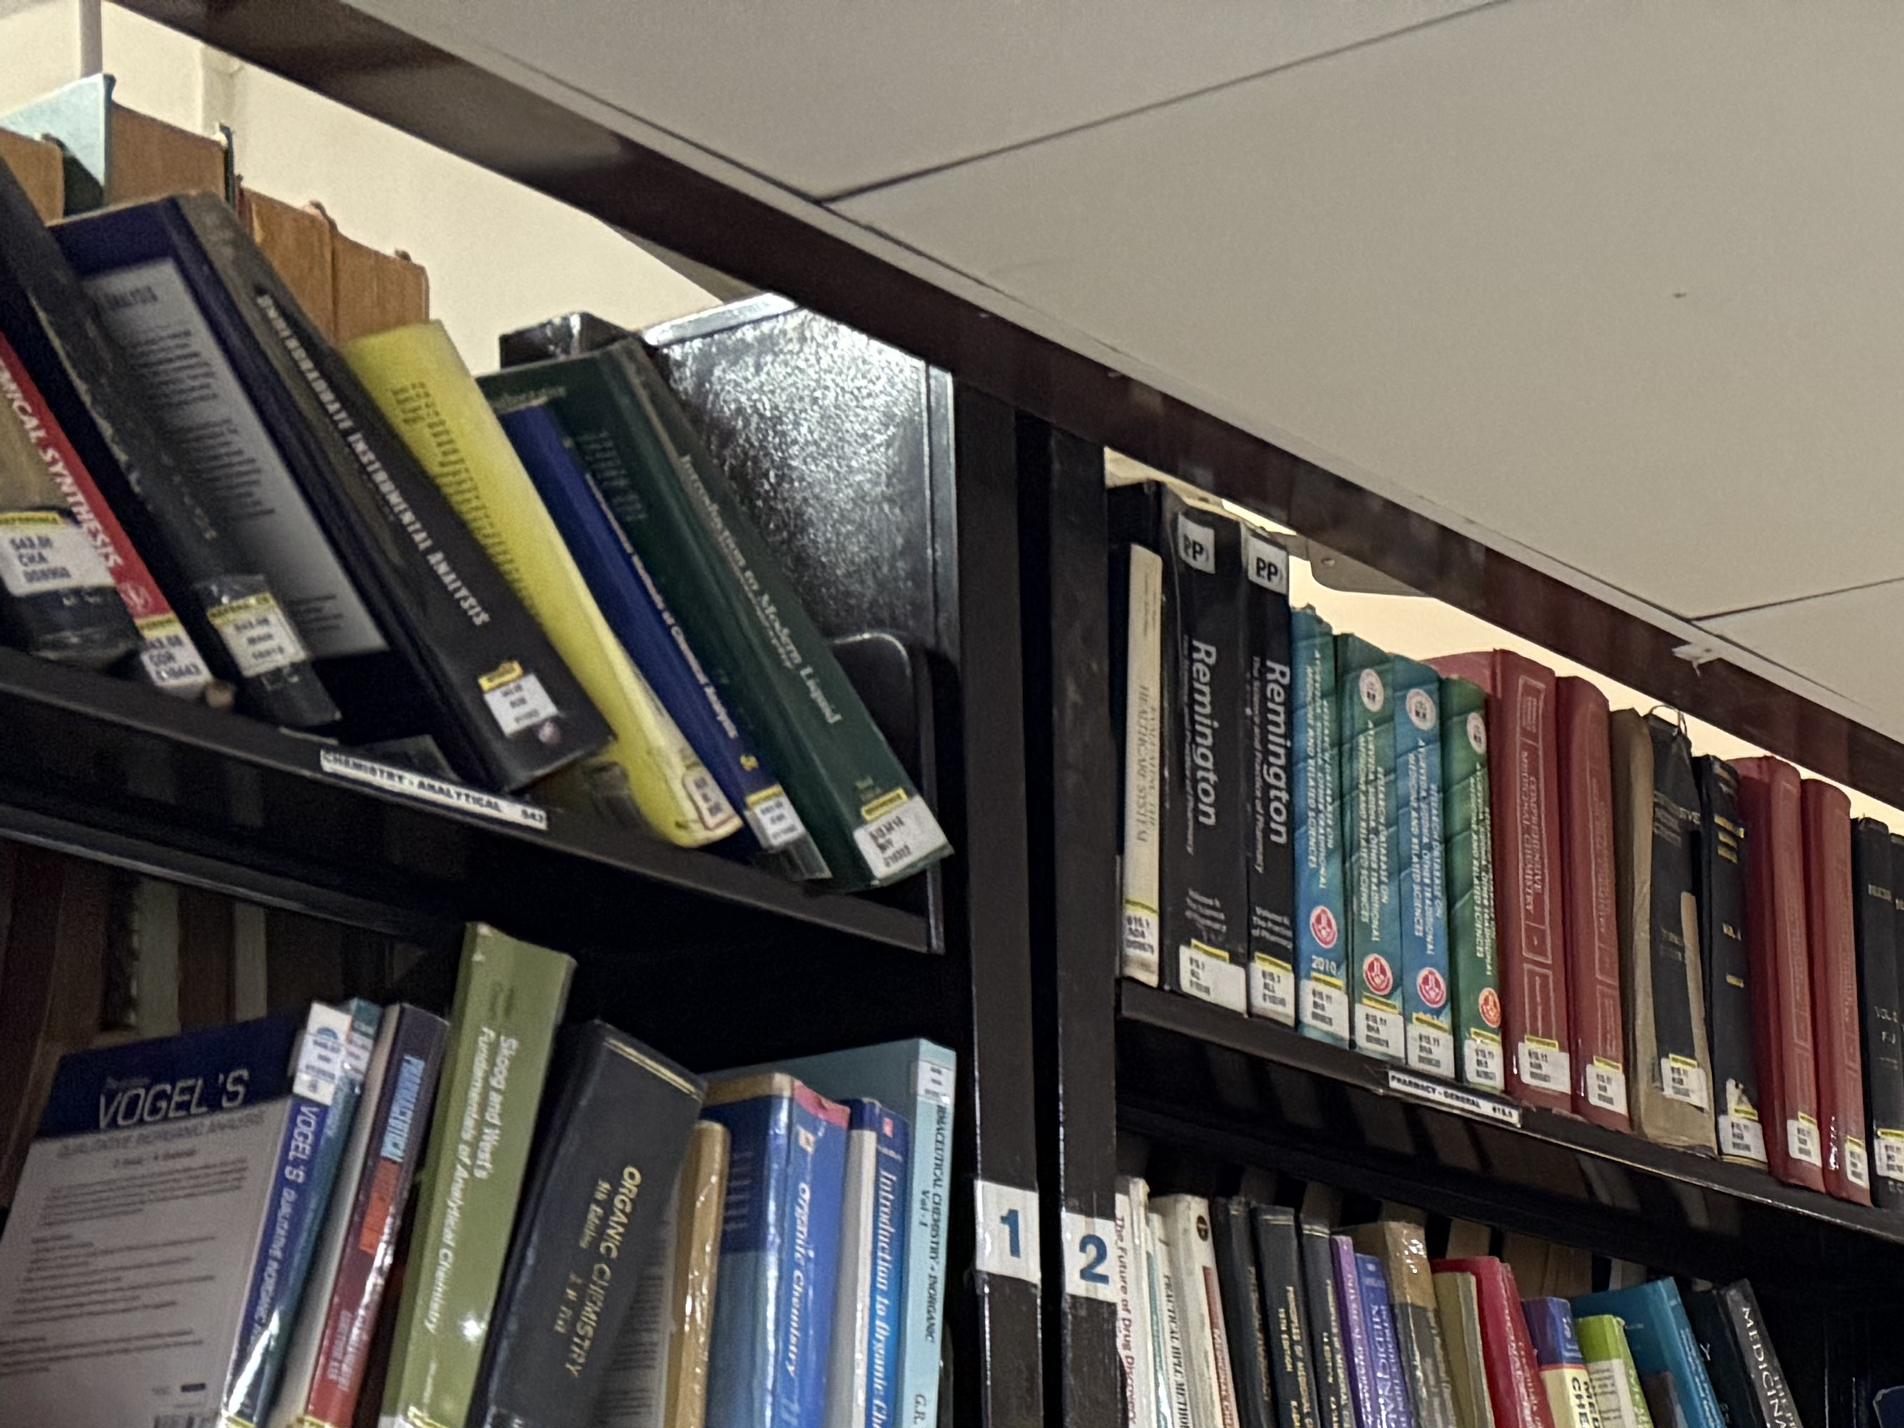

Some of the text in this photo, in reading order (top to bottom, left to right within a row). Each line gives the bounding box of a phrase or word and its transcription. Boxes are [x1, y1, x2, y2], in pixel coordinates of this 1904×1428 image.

[39, 447, 124, 569] SYNTHESIS
[426, 547, 491, 628] ANALYSIS
[760, 593, 843, 725] Modern Liquid
[1191, 639, 1218, 827] Remington
[1265, 658, 1291, 846] Remington
[322, 750, 504, 814] CHEMISTRY ANALYTICAL
[490, 1032, 521, 1090] Skoog
[1390, 1072, 1482, 1109] PHARMACY GENERAL
[284, 1105, 322, 1185] VOGEL'S
[425, 1166, 470, 1336] Analytical Chemistry
[874, 1169, 898, 1291] Introduction
[999, 1208, 1021, 1259] 1
[1078, 1234, 1110, 1286] 2
[1118, 1242, 1127, 1287] Future
[565, 1165, 642, 1378] ORGANIC CHEMISTRY
[785, 1270, 805, 1378] Chemistry
[871, 1320, 888, 1400] Organic
[1120, 1307, 1135, 1352] Drug
